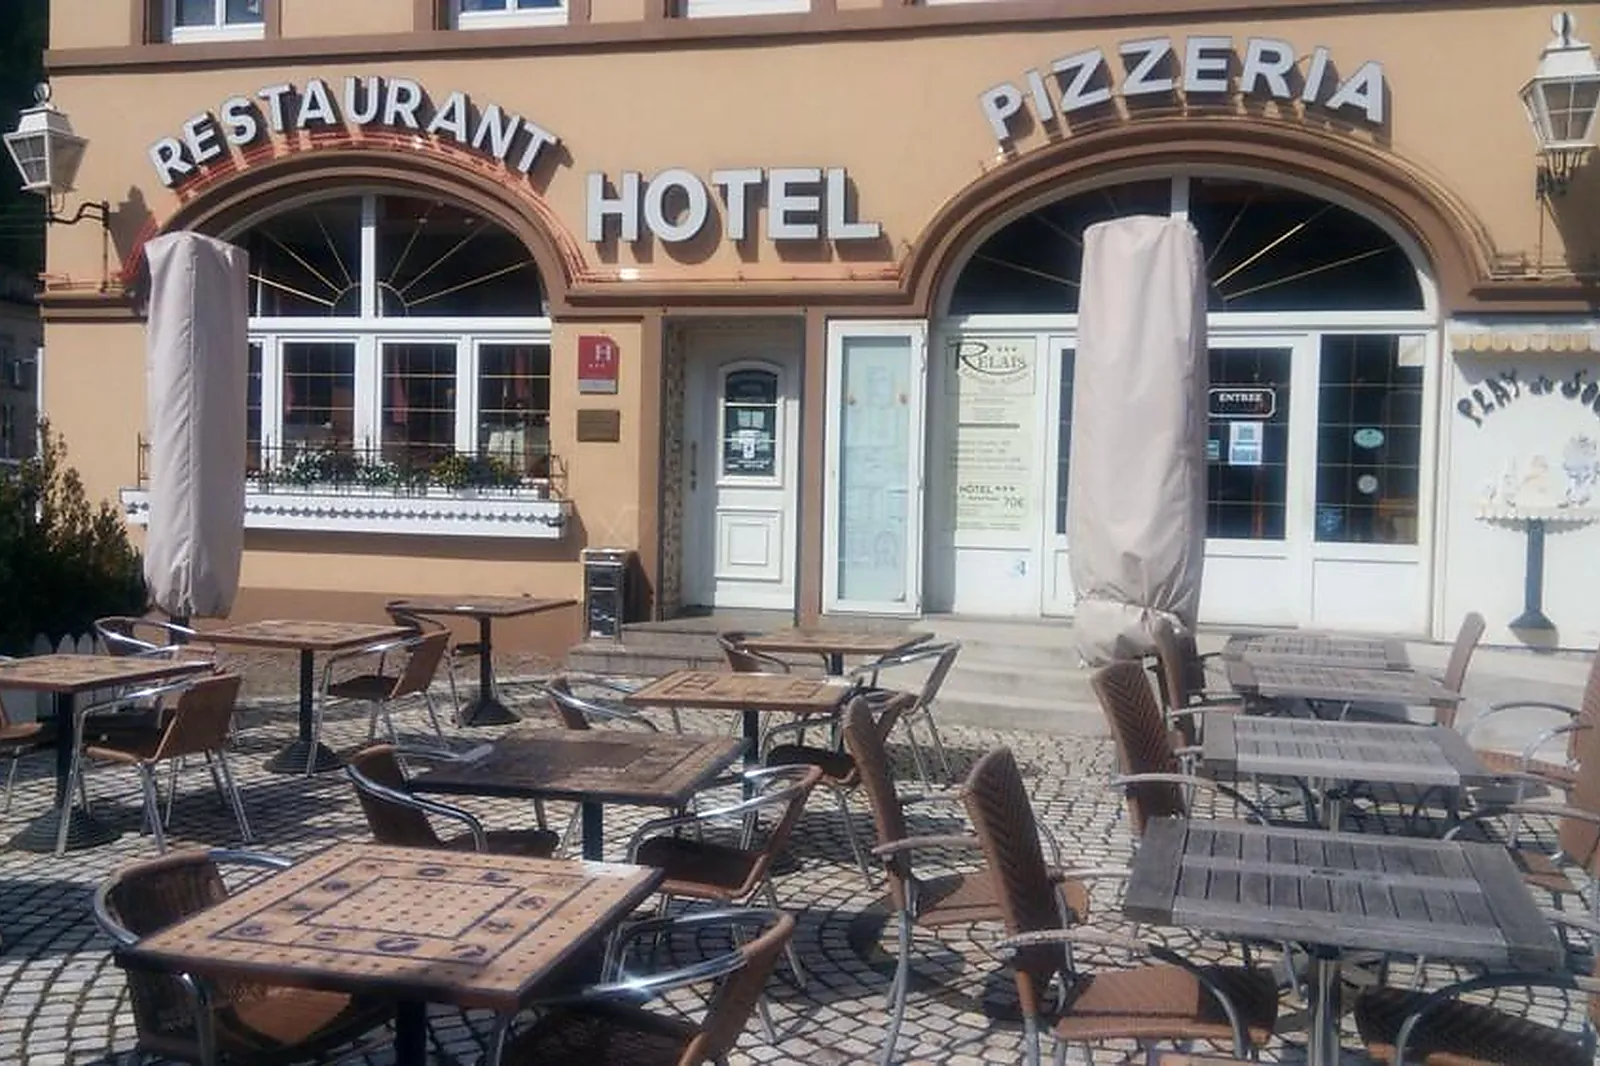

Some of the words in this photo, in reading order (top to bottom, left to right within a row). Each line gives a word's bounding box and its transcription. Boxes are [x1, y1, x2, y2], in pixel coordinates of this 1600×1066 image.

[148, 75, 558, 188] RESTAURANT
[979, 35, 1386, 140] PIZZERIA
[586, 166, 883, 242] HOTEL
